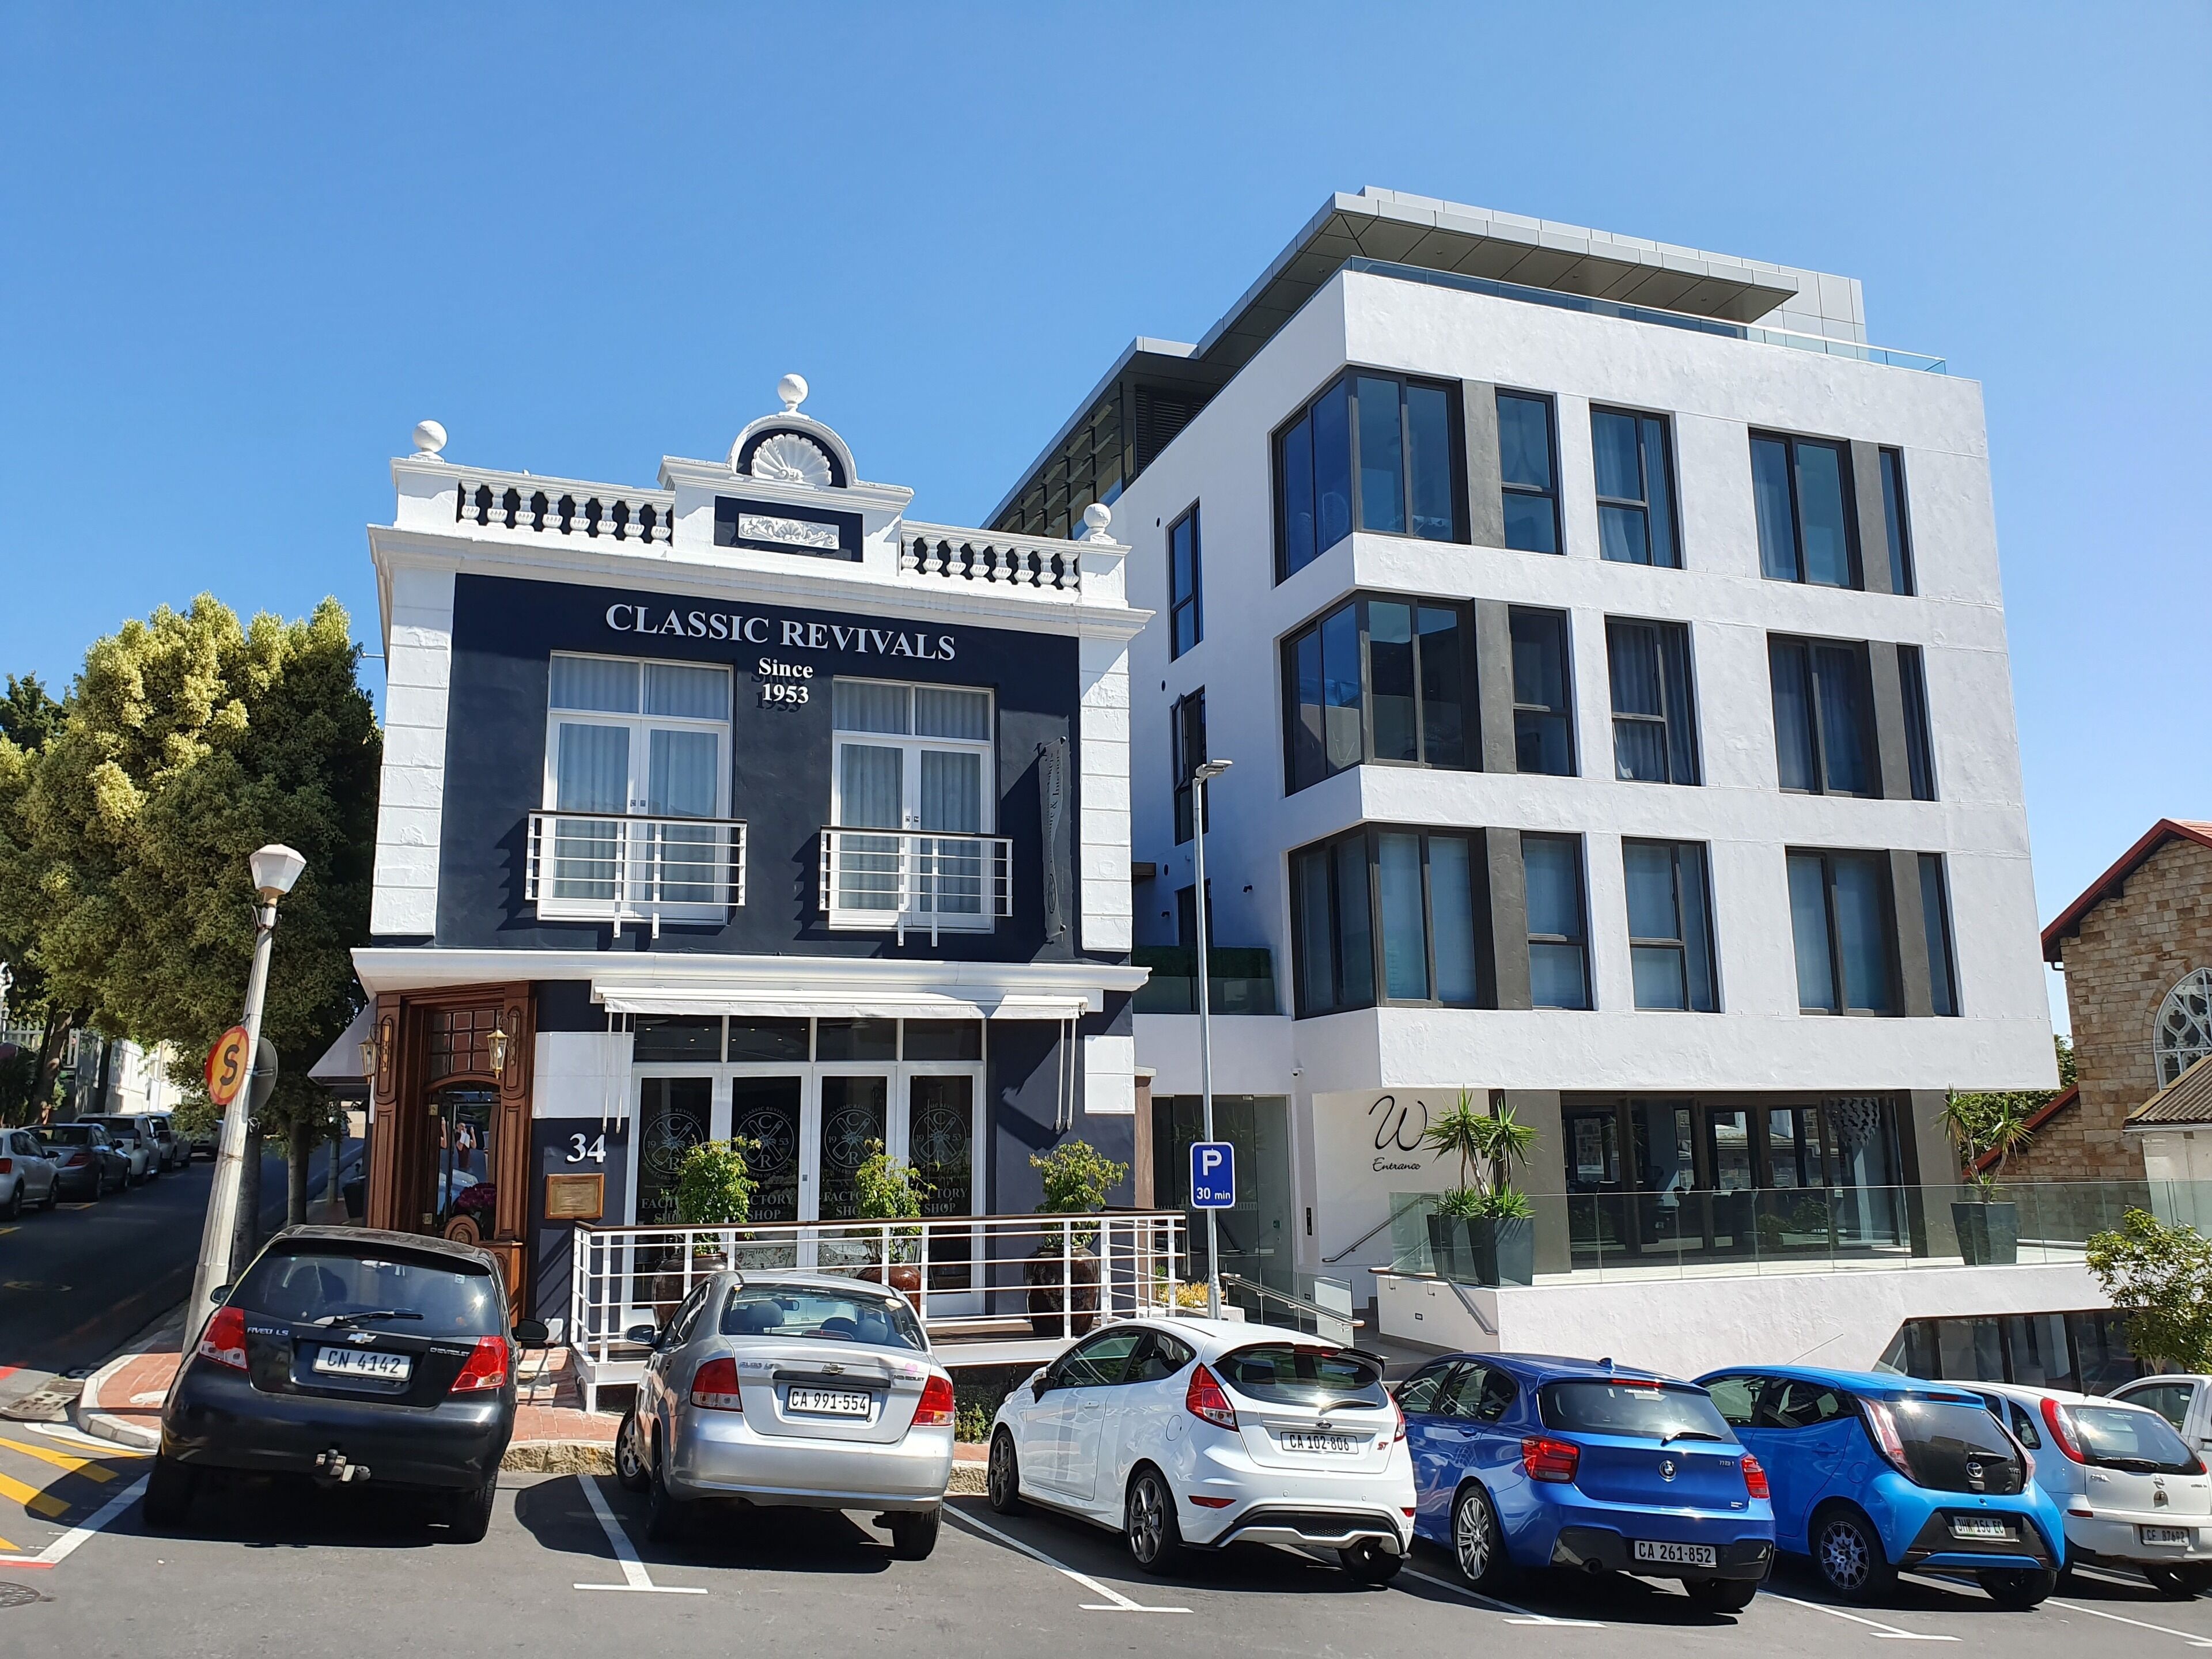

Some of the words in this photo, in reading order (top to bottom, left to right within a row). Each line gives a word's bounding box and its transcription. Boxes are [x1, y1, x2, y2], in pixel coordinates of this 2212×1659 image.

[605, 603, 769, 643] CLASSIC
[779, 620, 956, 661] REVIVALS
[758, 657, 813, 679] Since
[762, 683, 810, 704] 1953
[219, 1044, 240, 1086] S
[649, 1108, 674, 1121] CLASSIC
[675, 1108, 702, 1123] REVIVALS
[741, 1106, 765, 1120] CLASSIC
[766, 1106, 792, 1122] REVIVALS
[830, 1103, 853, 1117] CLASSIC
[917, 1103, 939, 1116] CLASIC
[667, 1116, 681, 1131] C
[758, 1115, 772, 1129] C
[846, 1112, 859, 1126] C
[933, 1111, 946, 1125] C
[1368, 1095, 1427, 1152] W
[647, 1140, 657, 1149] 19
[779, 1138, 789, 1146] 53
[828, 1135, 837, 1143] 19
[566, 1133, 607, 1162] 34
[668, 1157, 680, 1171] R
[759, 1154, 772, 1168] R
[847, 1152, 861, 1165] R
[1202, 1150, 1222, 1176] P
[1372, 1157, 1421, 1172] Entrance
[750, 1194, 794, 1206] CTORY
[1196, 1187, 1211, 1200] 30
[1214, 1190, 1230, 1200] min
[924, 1202, 956, 1214] SHOP
[747, 1210, 781, 1221] SHOP
[247, 1327, 273, 1335] AVEO
[327, 1350, 350, 1369] CN
[357, 1355, 402, 1374] 4142
[791, 1391, 807, 1407] CA
[814, 1392, 866, 1411] 991-554
[1289, 1434, 1304, 1449] CA
[1306, 1435, 1350, 1452] 102-806
[1975, 1520, 1991, 1533] 156
[1993, 1521, 2003, 1533] EC
[2146, 1529, 2156, 1541] CF
[1638, 1543, 1655, 1559] CA
[1660, 1544, 1712, 1563] 261-852
